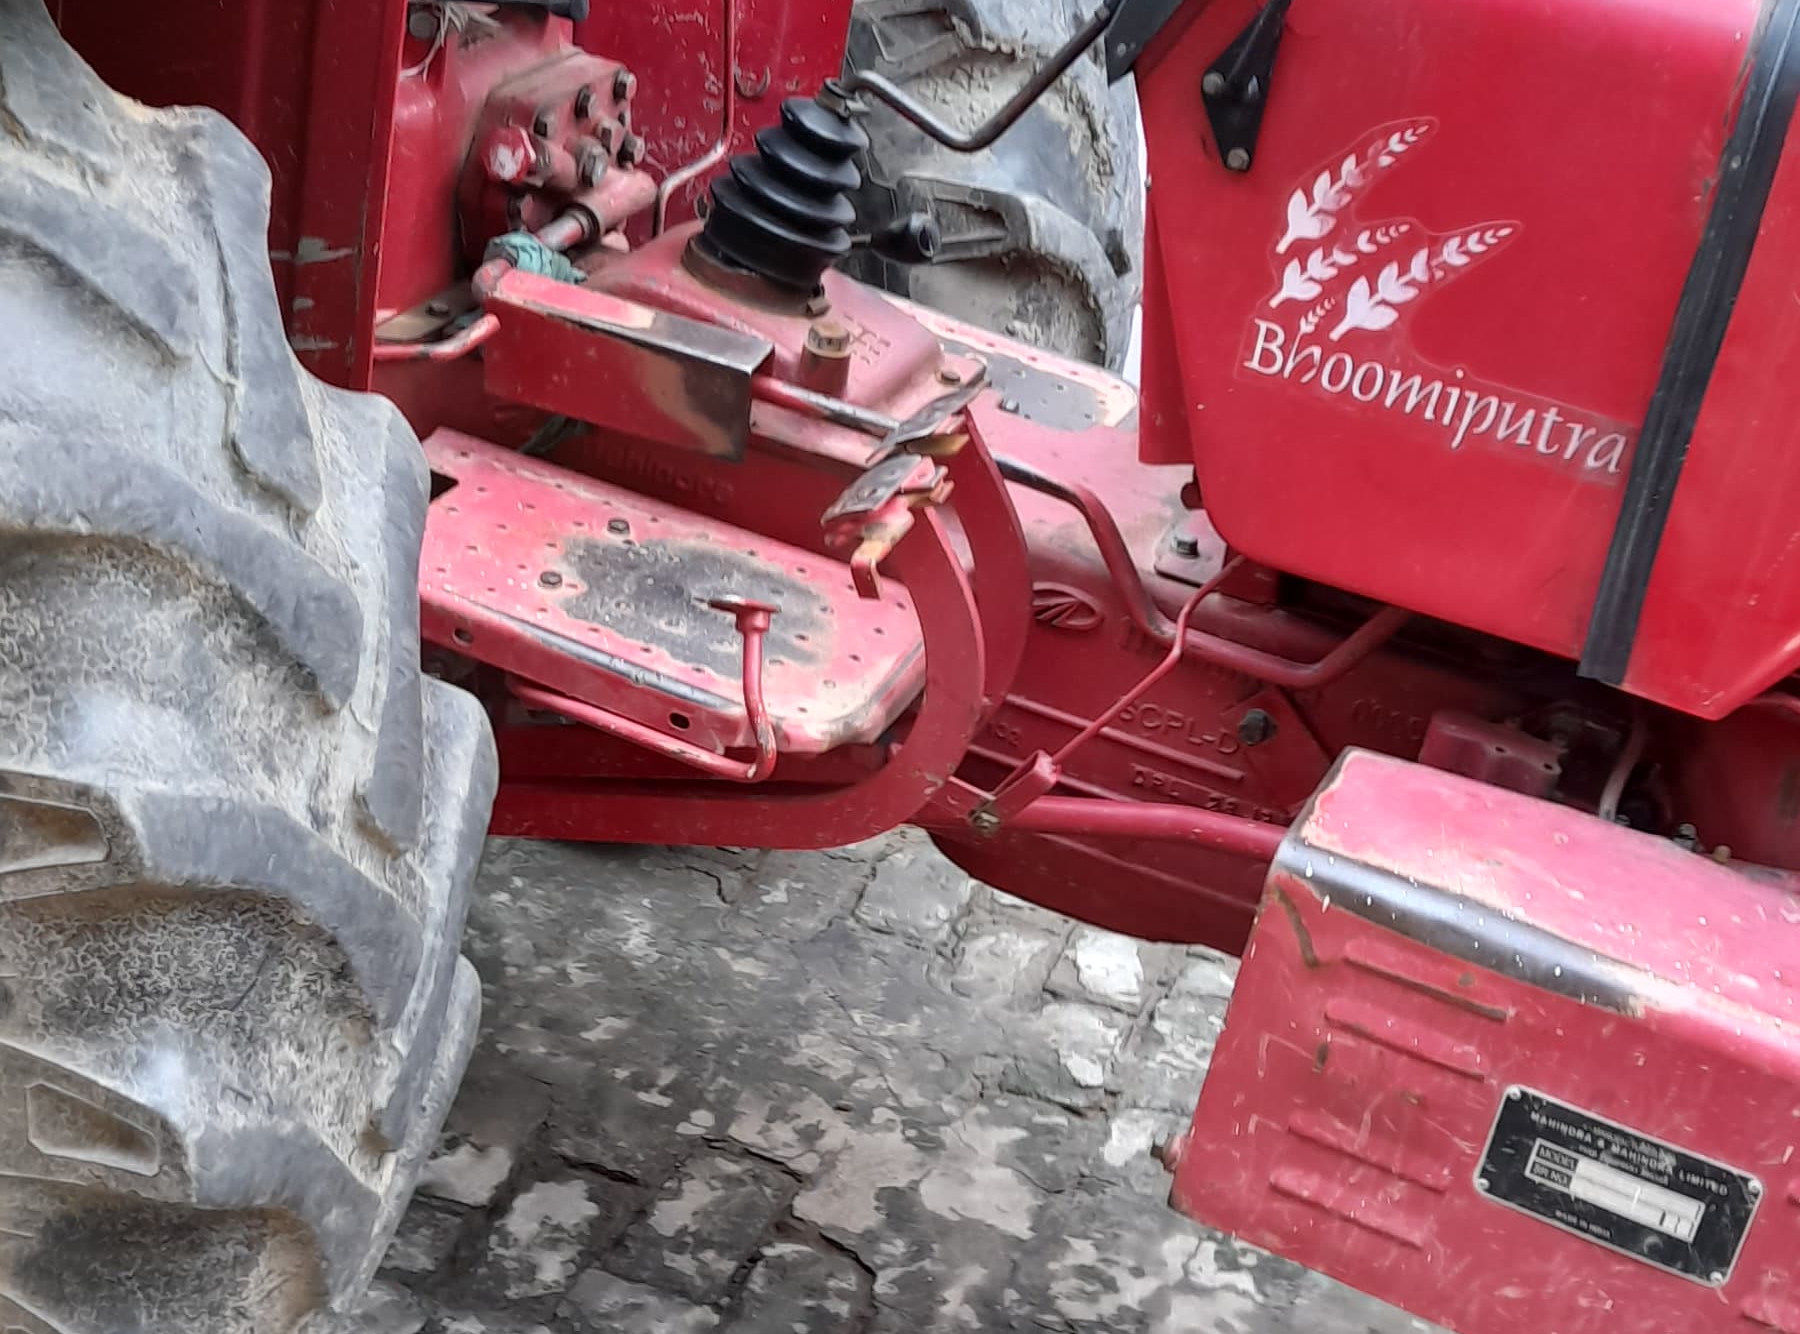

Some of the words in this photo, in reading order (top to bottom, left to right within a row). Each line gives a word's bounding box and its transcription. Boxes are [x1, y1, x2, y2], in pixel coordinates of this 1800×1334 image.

[1243, 315, 1629, 473] Bhoomiputra
[1531, 1111, 1593, 1144] MAHINDRA
[1611, 1144, 1673, 1175] MAHINDRA
[1679, 1170, 1728, 1196] LIMITED
